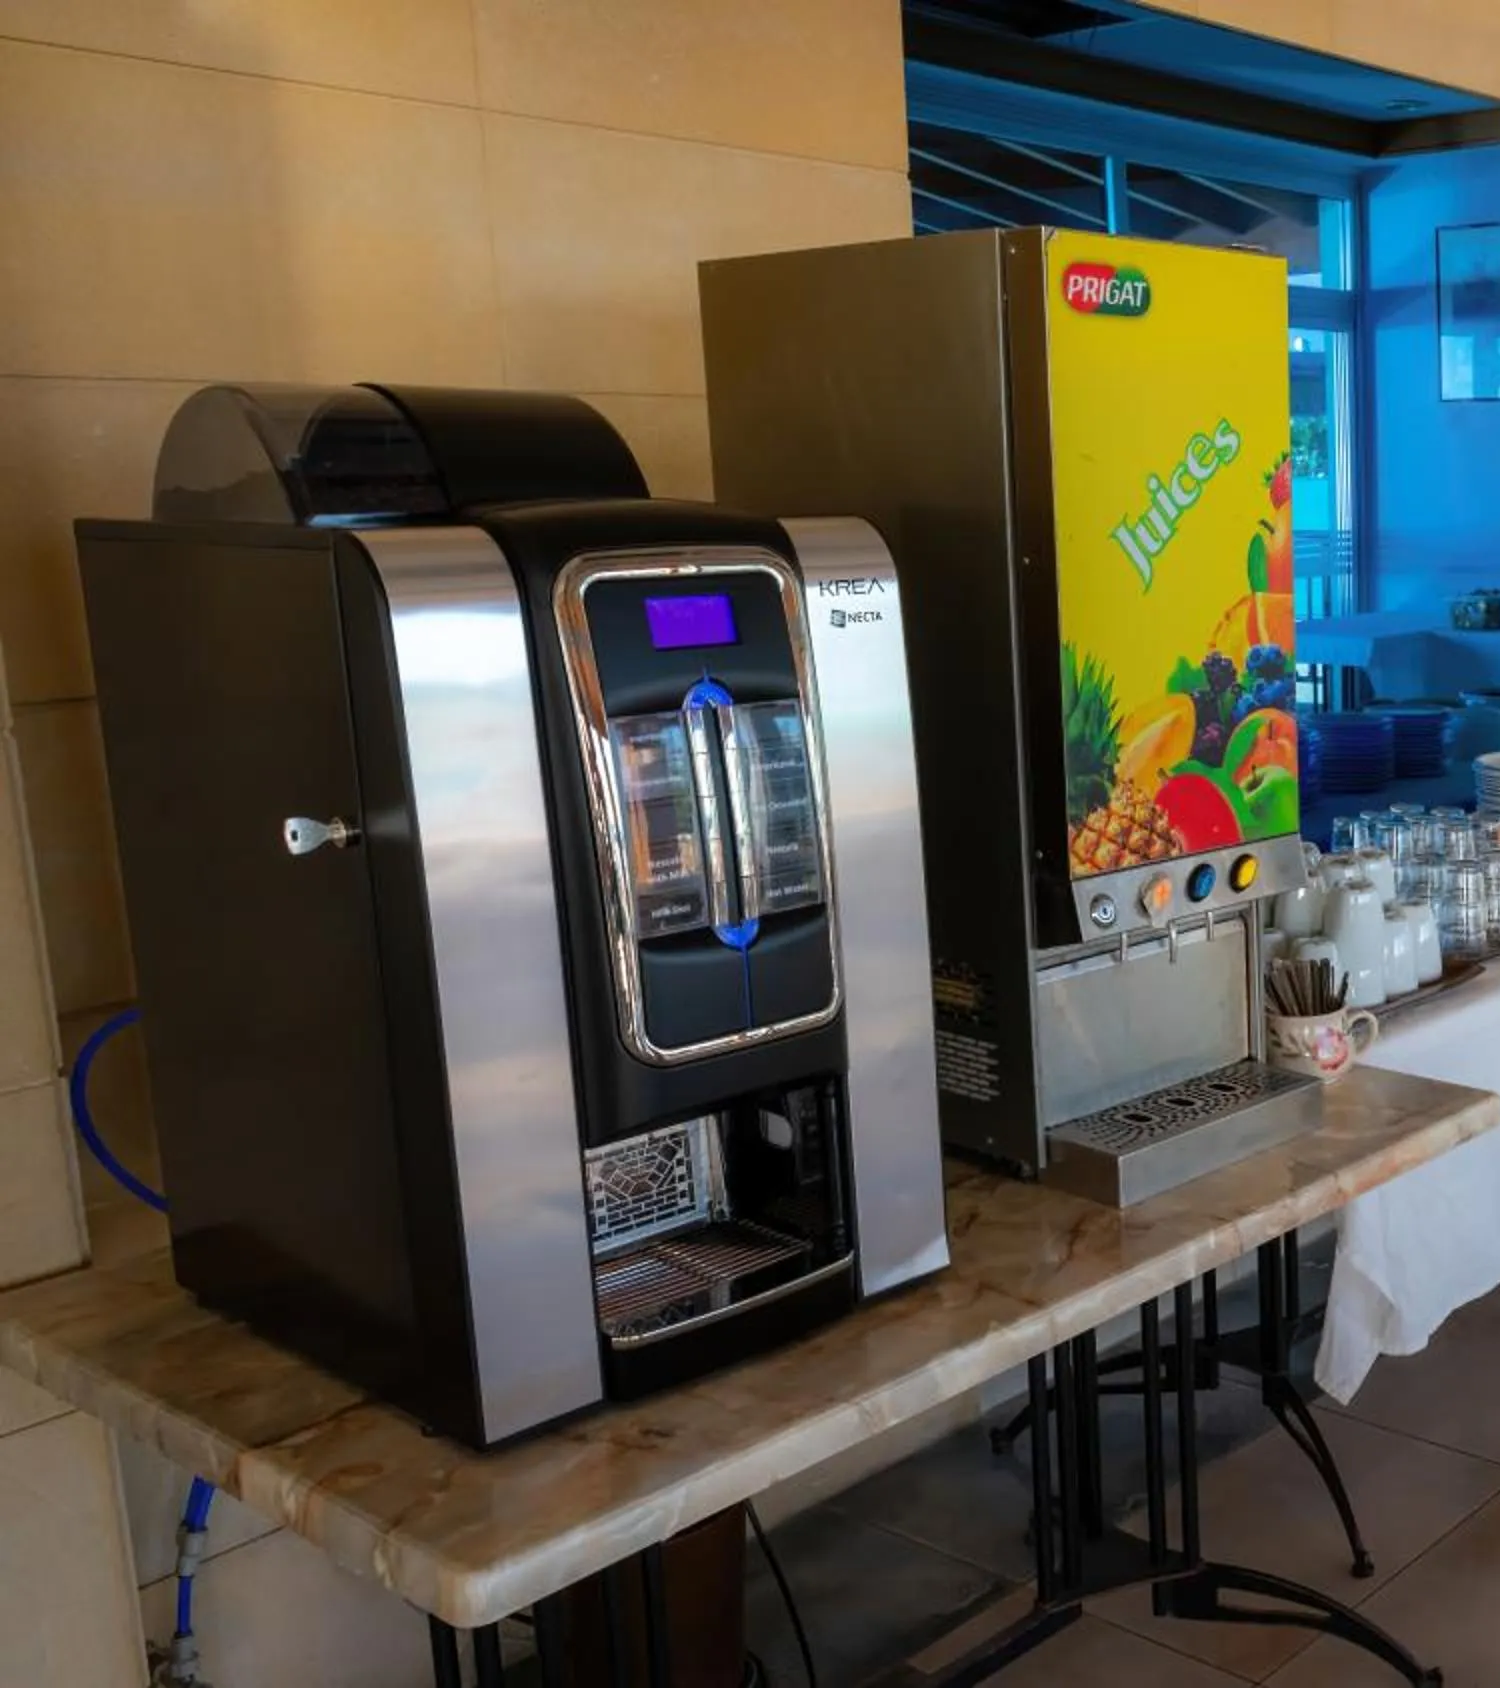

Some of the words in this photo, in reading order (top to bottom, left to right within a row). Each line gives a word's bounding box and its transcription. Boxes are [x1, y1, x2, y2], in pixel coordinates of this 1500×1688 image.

[1067, 274, 1147, 307] PRIGAT
[1109, 417, 1241, 595] Juices
[819, 577, 885, 597] KREA
[847, 611, 884, 623] NECTA
